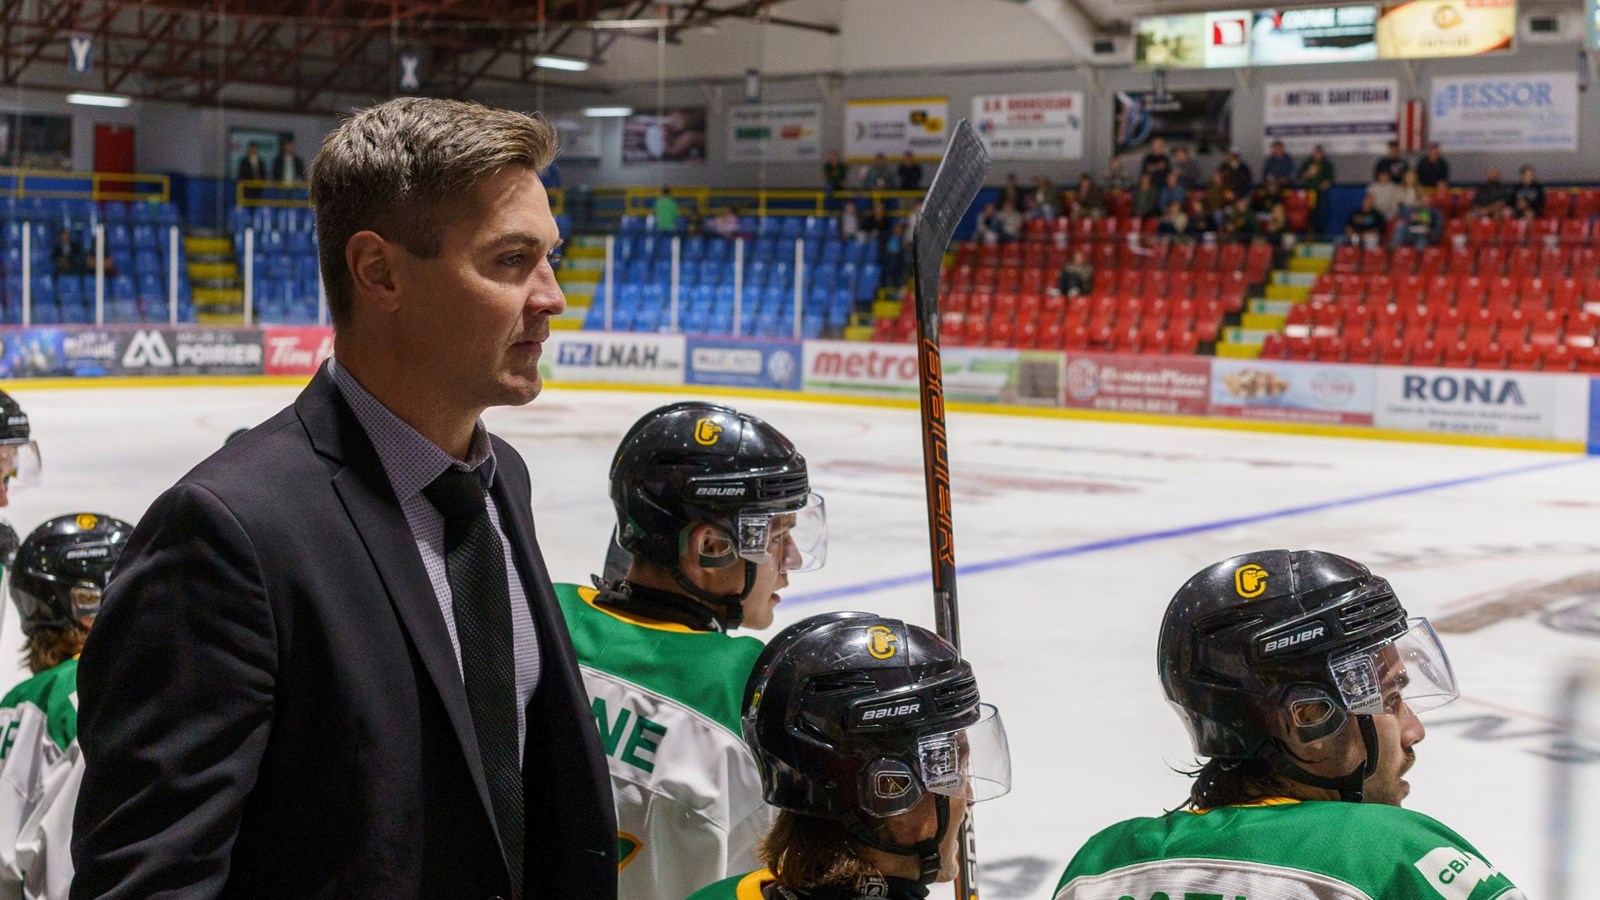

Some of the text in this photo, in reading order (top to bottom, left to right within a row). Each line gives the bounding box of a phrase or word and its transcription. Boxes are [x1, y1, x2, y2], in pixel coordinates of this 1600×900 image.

[1462, 81, 1553, 108] ESSOR
[176, 343, 263, 366] POIRIER
[812, 350, 918, 379] metro
[1403, 374, 1525, 406] RONA
[695, 486, 747, 497] BAUER
[1264, 626, 1325, 653] BAUER
[861, 703, 921, 721] BAUER
